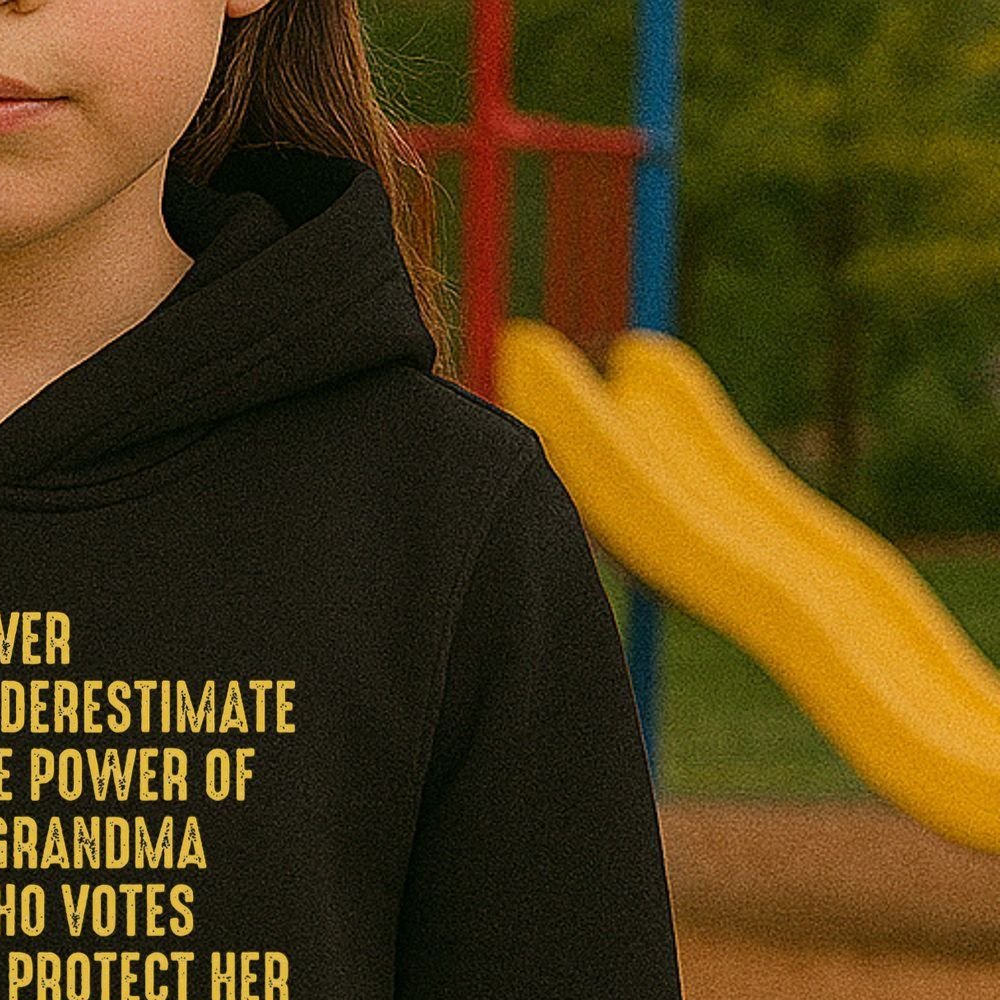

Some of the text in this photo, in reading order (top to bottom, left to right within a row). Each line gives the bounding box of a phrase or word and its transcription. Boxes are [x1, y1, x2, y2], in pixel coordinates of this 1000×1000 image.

[31, 748, 187, 801] POWER
[206, 748, 255, 801] OF
[62, 884, 193, 936] VOTES
